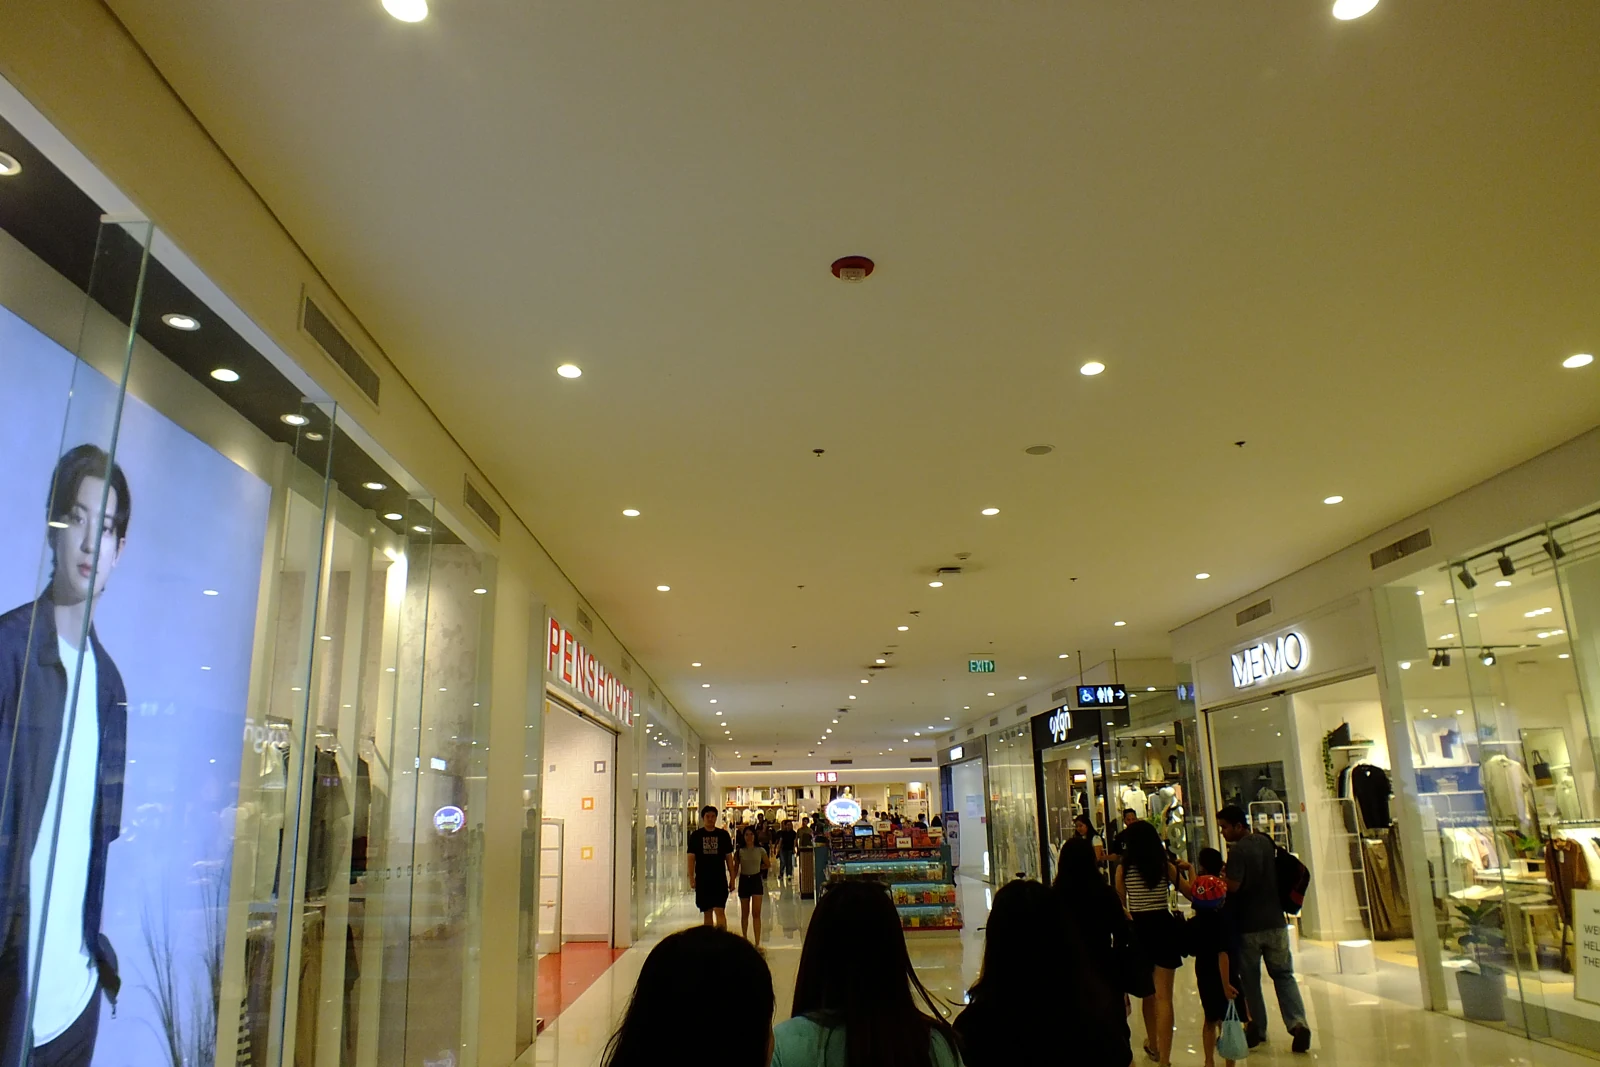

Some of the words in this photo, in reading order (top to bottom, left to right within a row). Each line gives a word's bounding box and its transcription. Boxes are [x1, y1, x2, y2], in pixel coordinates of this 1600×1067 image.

[547, 617, 633, 726] PENSHOPPE
[970, 660, 989, 672] EXIT
[1229, 631, 1307, 688] MEMO
